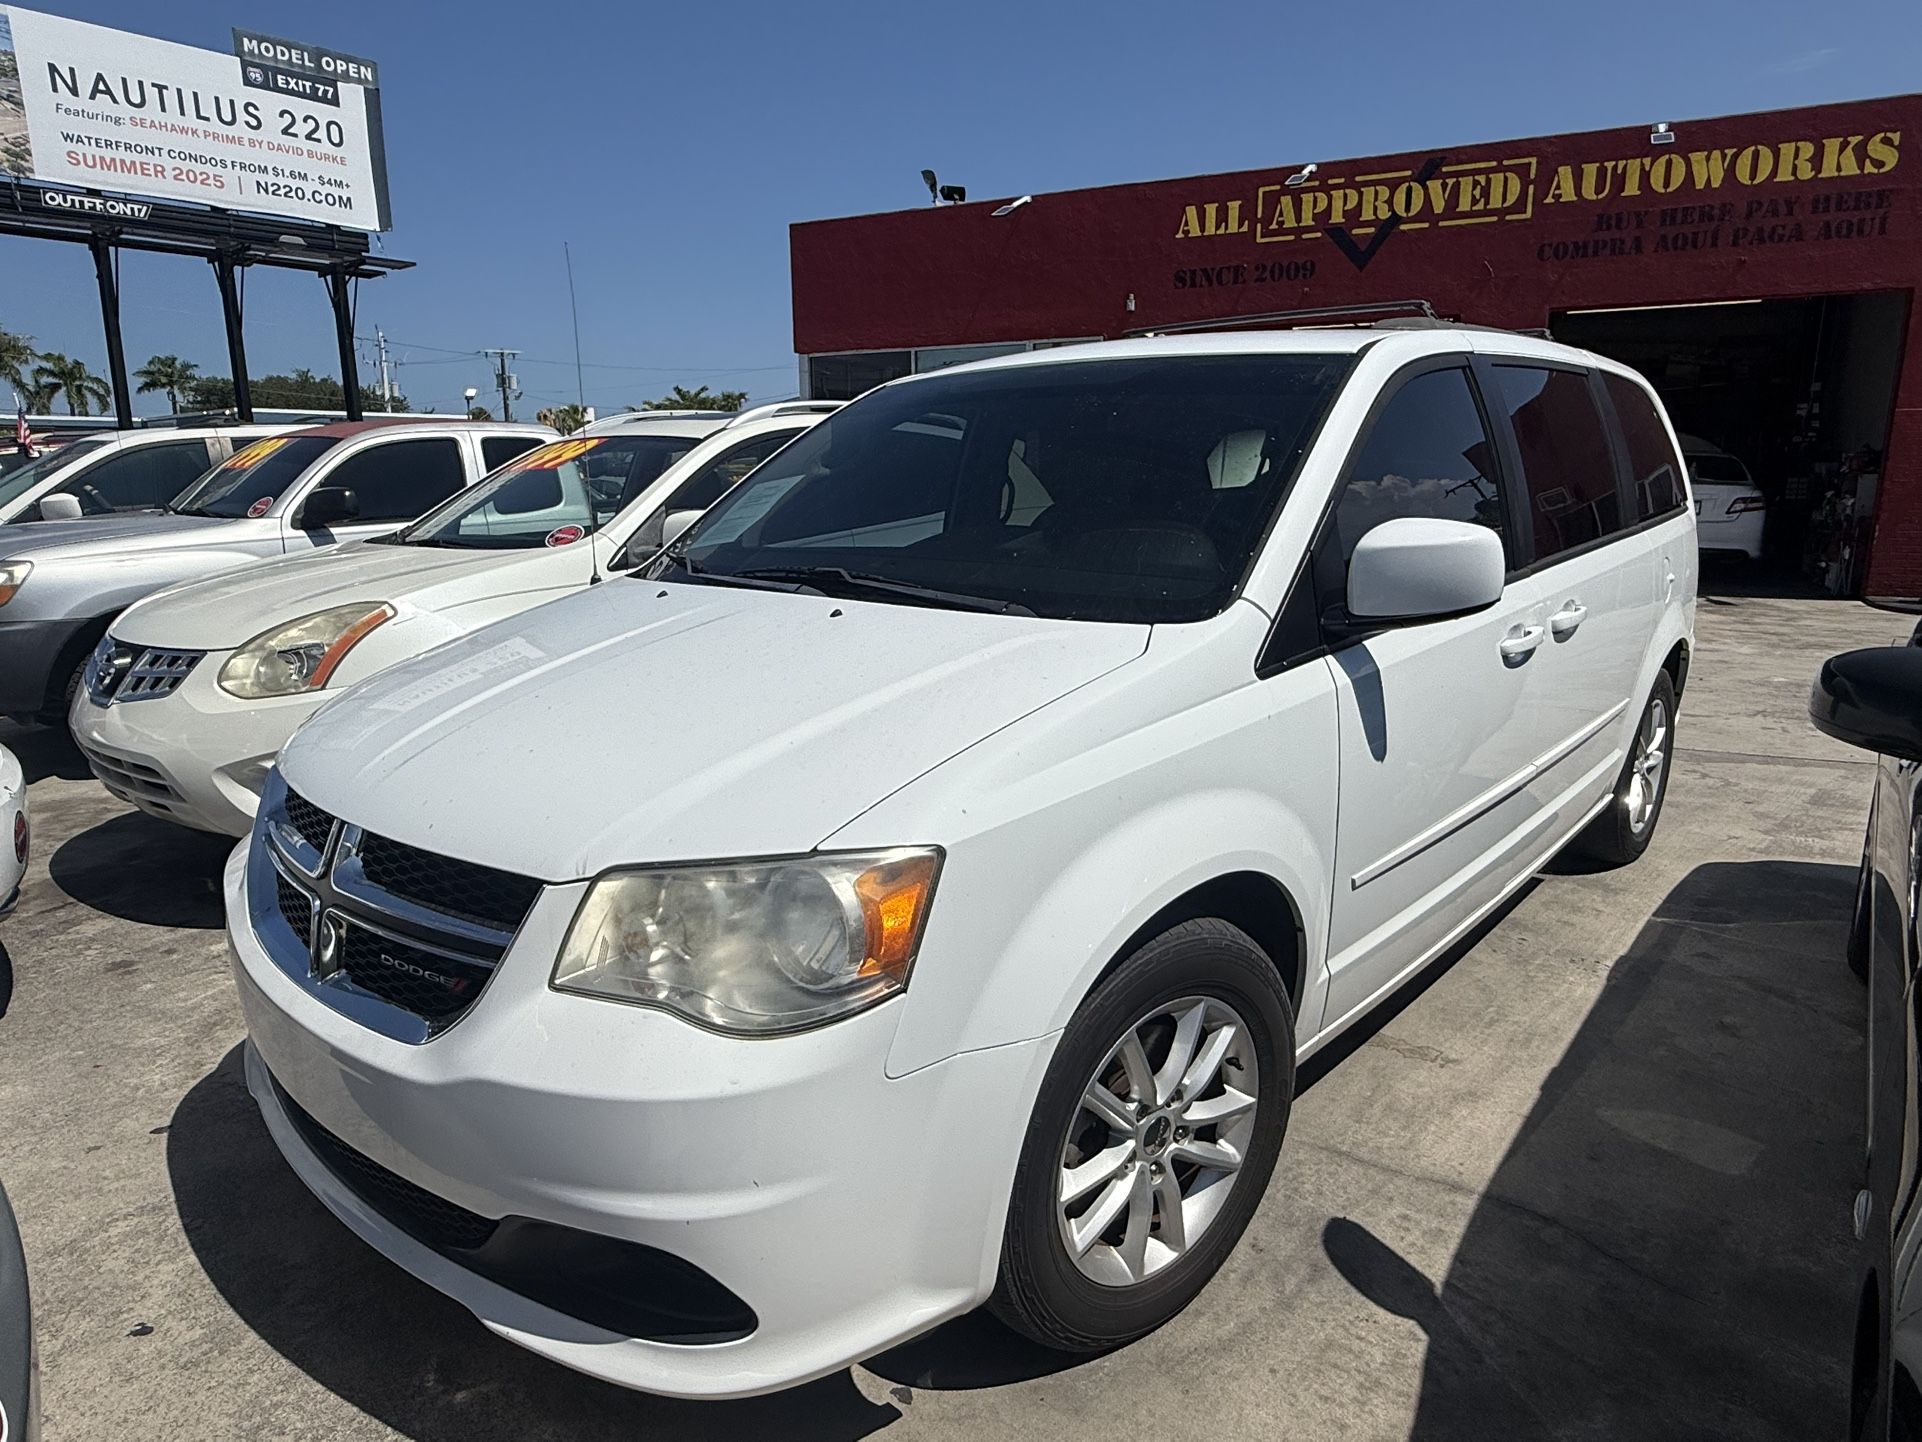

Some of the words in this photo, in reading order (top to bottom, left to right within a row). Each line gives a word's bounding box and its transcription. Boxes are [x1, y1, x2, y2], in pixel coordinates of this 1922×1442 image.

[242, 37, 315, 68] MODEL
[321, 56, 373, 81] OPEN
[249, 71, 262, 81] 95
[47, 61, 263, 131] NAUTILUS
[278, 109, 344, 148] 220
[276, 74, 313, 94] EXIT
[315, 83, 334, 99] 77
[55, 103, 126, 126] Featuring:
[129, 116, 200, 139] SEAHAWK
[203, 129, 245, 147] PRIME
[248, 137, 264, 150] BY
[267, 141, 304, 157] DAVID
[307, 149, 348, 167] BURKE
[60, 131, 164, 158] WATERFRONT
[167, 149, 228, 170] CONDOS
[231, 160, 269, 176] FROM
[272, 165, 309, 183] $1.6M
[318, 174, 351, 190] $4M+
[66, 150, 167, 180] SUMMER
[172, 166, 225, 190] 2025
[256, 180, 354, 211] N220.COM
[1175, 200, 1249, 239] ALL
[1268, 171, 1522, 230] APPROVED
[1543, 131, 1902, 204] AUTOWORKS
[1595, 211, 1650, 234] BUY
[1659, 202, 1736, 228] HERE
[1744, 197, 1800, 221] PAY
[1809, 189, 1894, 214] HERE
[1536, 232, 1644, 263] COMPRA
[1730, 222, 1805, 249] PAGA
[1173, 262, 1248, 290] SINCE
[1253, 258, 1317, 284] 2009
[380, 953, 456, 989] DODGE
